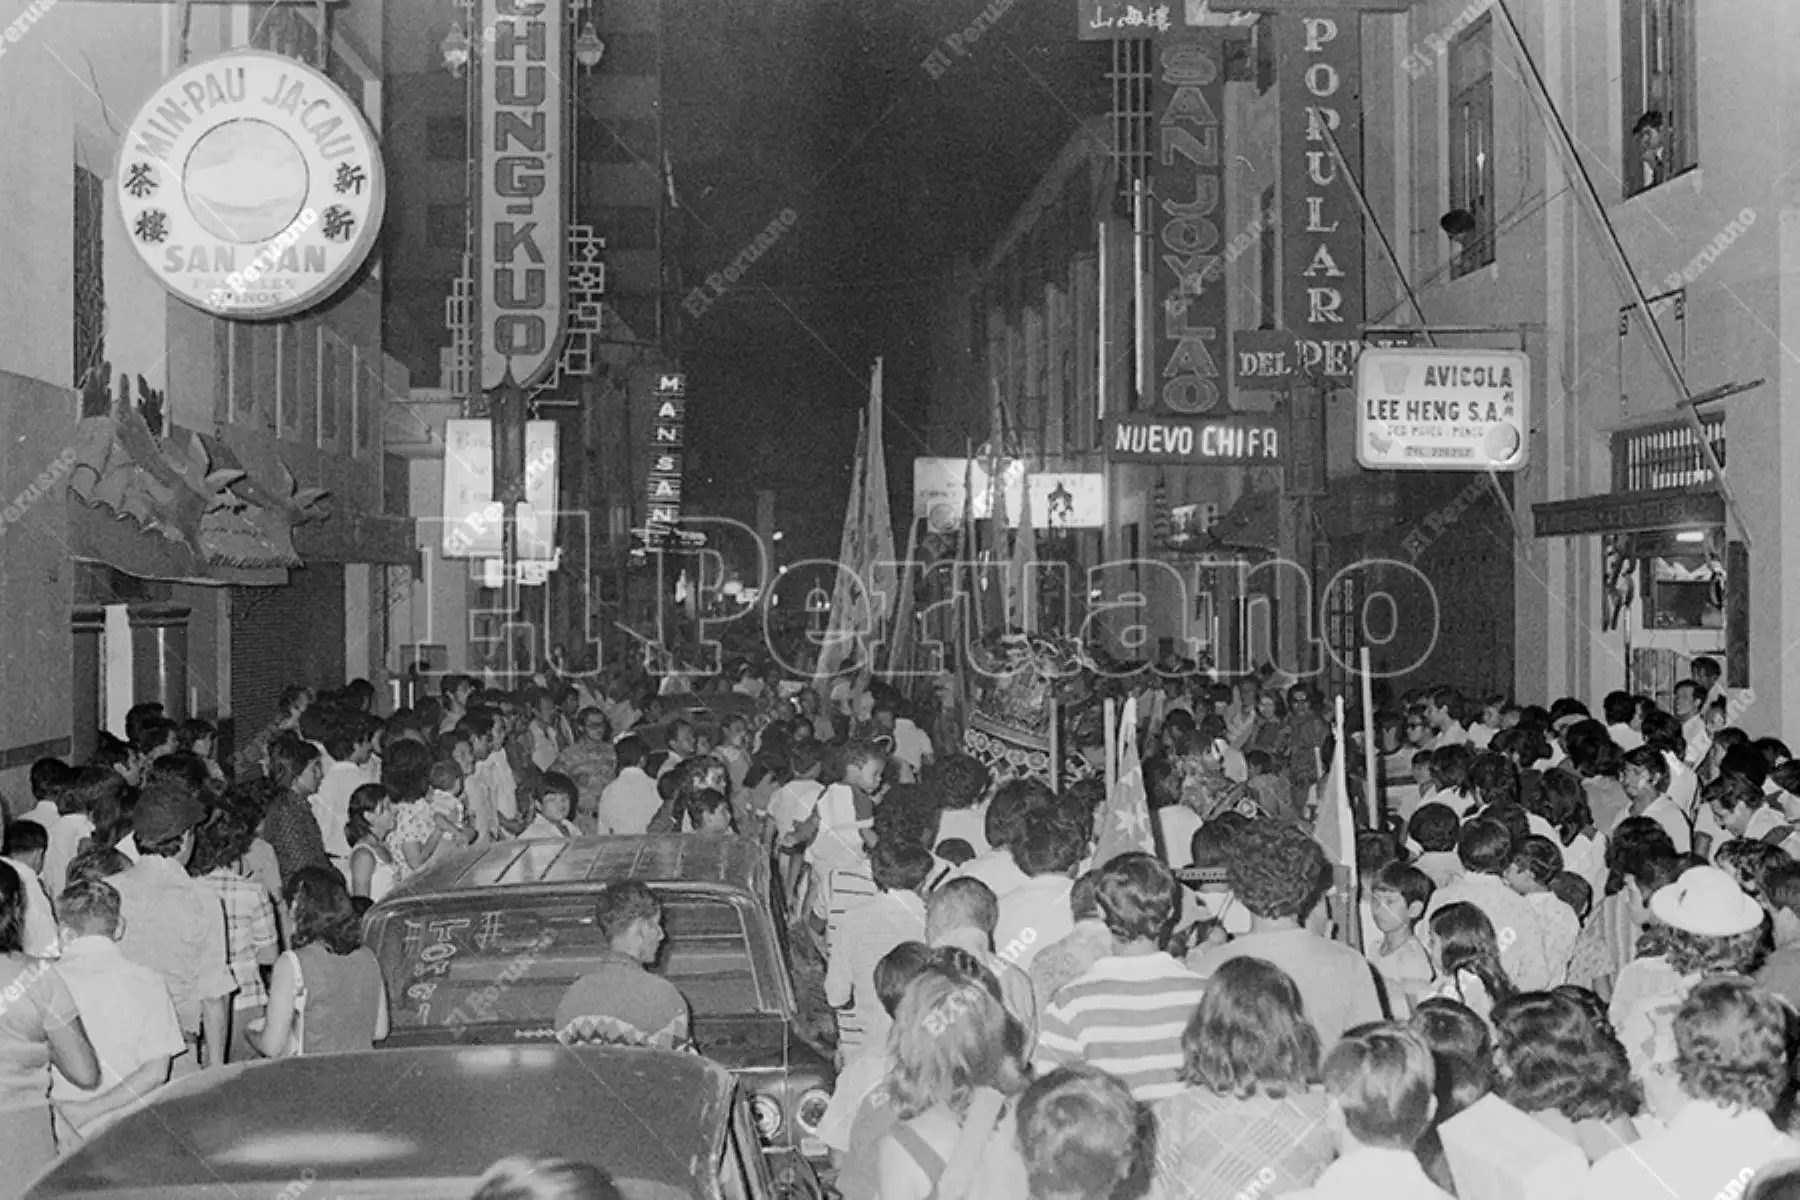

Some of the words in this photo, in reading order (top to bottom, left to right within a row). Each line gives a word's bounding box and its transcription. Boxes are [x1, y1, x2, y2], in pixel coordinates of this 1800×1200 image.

[134, 66, 247, 162] MIN-PAU
[261, 73, 357, 162] JA-CAU
[1302, 17, 1345, 324] POPULAR
[163, 243, 237, 274] SAN
[1239, 350, 1293, 377] DEL
[1423, 364, 1514, 389] AVICOLA
[1366, 399, 1401, 421] LEE
[1405, 399, 1461, 423] HENG
[1467, 400, 1504, 423] S.A.
[1115, 423, 1194, 455] NUEVO
[1201, 424, 1279, 459] CHIFA
